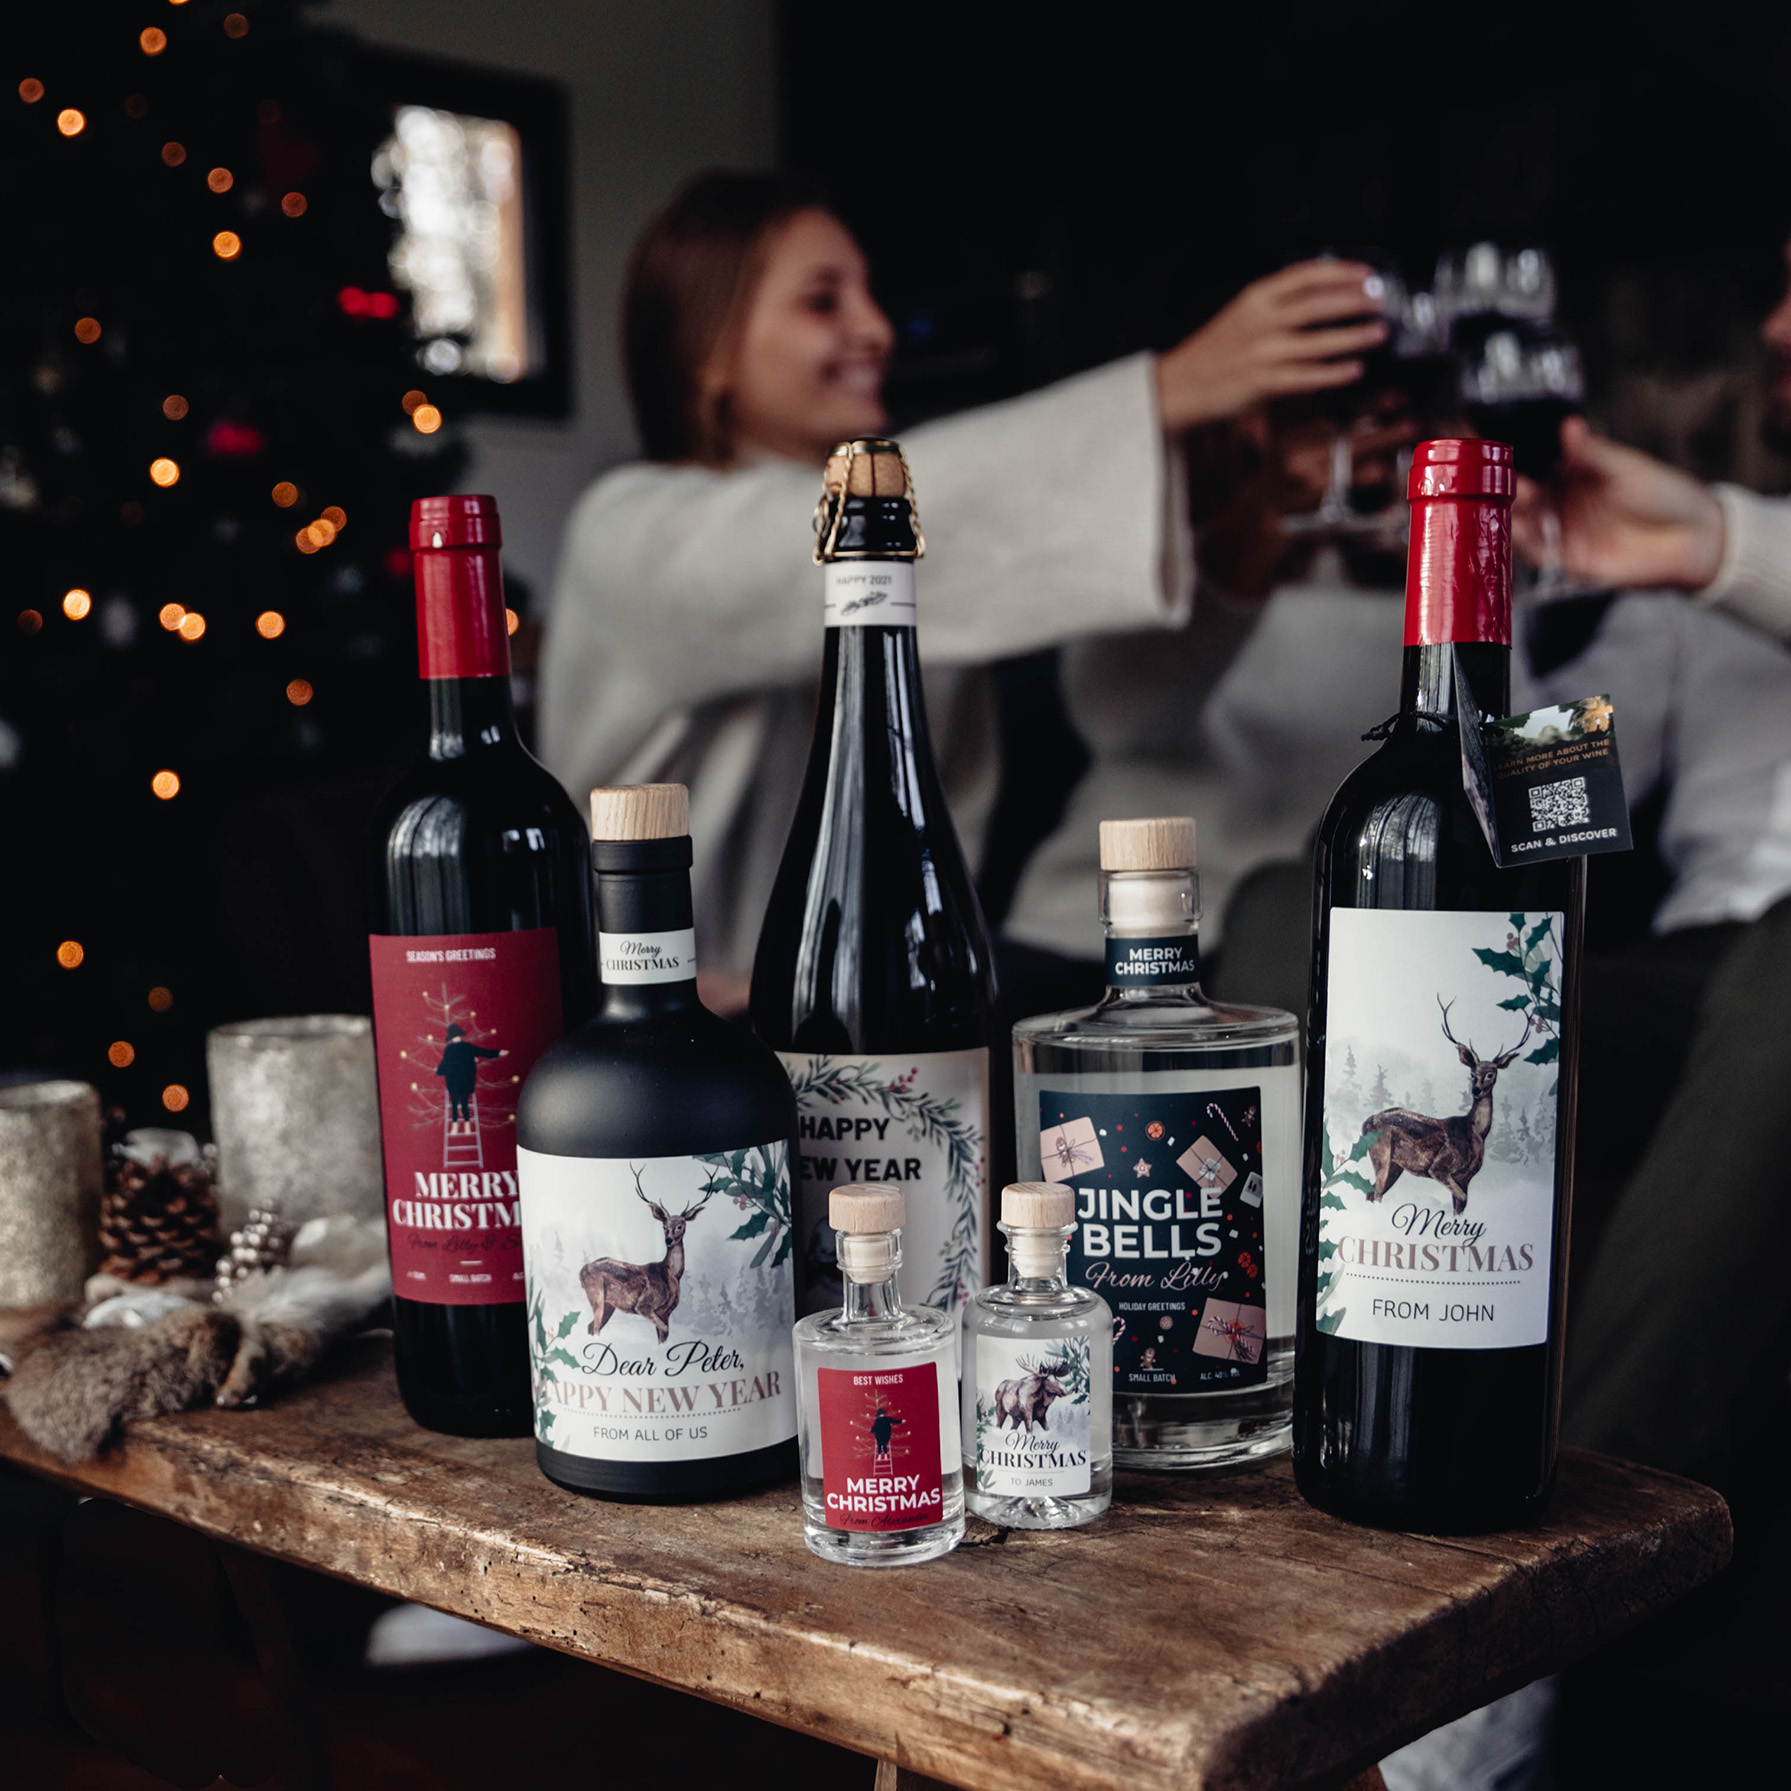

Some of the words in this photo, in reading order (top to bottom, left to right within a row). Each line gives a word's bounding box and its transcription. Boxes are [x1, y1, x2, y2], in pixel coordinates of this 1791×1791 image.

[869, 575, 892, 585] 2021
[1526, 751, 1554, 764] MORE
[1556, 743, 1589, 757] ABOUT
[1591, 738, 1610, 749] THE
[1538, 760, 1549, 770] OF
[1552, 754, 1580, 767] YOUR
[1582, 748, 1609, 761] WINE
[1510, 840, 1542, 853] SCAN
[1545, 837, 1556, 847] &
[1559, 827, 1618, 844] DISCOVER
[445, 948, 496, 962] GREETINGS
[620, 940, 662, 958] Merry
[1129, 947, 1183, 961] MERRY
[606, 956, 680, 971] CHRISTMAS
[1115, 959, 1196, 975] CHRISTMAS
[800, 1115, 890, 1141] HAPPY
[800, 1155, 838, 1182] EW
[844, 1157, 921, 1182] YEAR
[414, 1170, 519, 1199] MERRY
[392, 1198, 522, 1230] CHRISTM
[1077, 1188, 1223, 1221] JINGLE
[1391, 1203, 1487, 1248] Merry
[1083, 1222, 1222, 1259] BELLS
[1337, 1235, 1534, 1273] CHRISTMAS
[1085, 1260, 1155, 1289] From
[1160, 1260, 1225, 1292] Lilly
[1119, 1301, 1146, 1311] HOLIDAY
[1147, 1301, 1186, 1311] GREETINGS
[1372, 1298, 1429, 1320] FROM
[1439, 1303, 1494, 1322] JOHN
[581, 1342, 656, 1377] Dear
[664, 1339, 744, 1377] Peter,
[853, 1375, 872, 1386] BEST
[874, 1373, 904, 1386] WISHES
[1128, 1373, 1150, 1383] SMALL
[1153, 1373, 1176, 1383] BATCH
[622, 1385, 700, 1414] NEW
[708, 1370, 782, 1409] YEAR
[594, 1426, 629, 1441] FROM
[635, 1428, 660, 1441] ALL
[665, 1427, 684, 1441] OF
[690, 1426, 708, 1439] US
[1005, 1430, 1060, 1455] Merry
[980, 1448, 1087, 1469] CHRISTMAS
[846, 1474, 920, 1494] MERRY
[1010, 1477, 1021, 1486] TO
[1025, 1478, 1054, 1487] JAMES
[827, 1487, 941, 1512] CHRISTMAS
[841, 1513, 868, 1526] From
